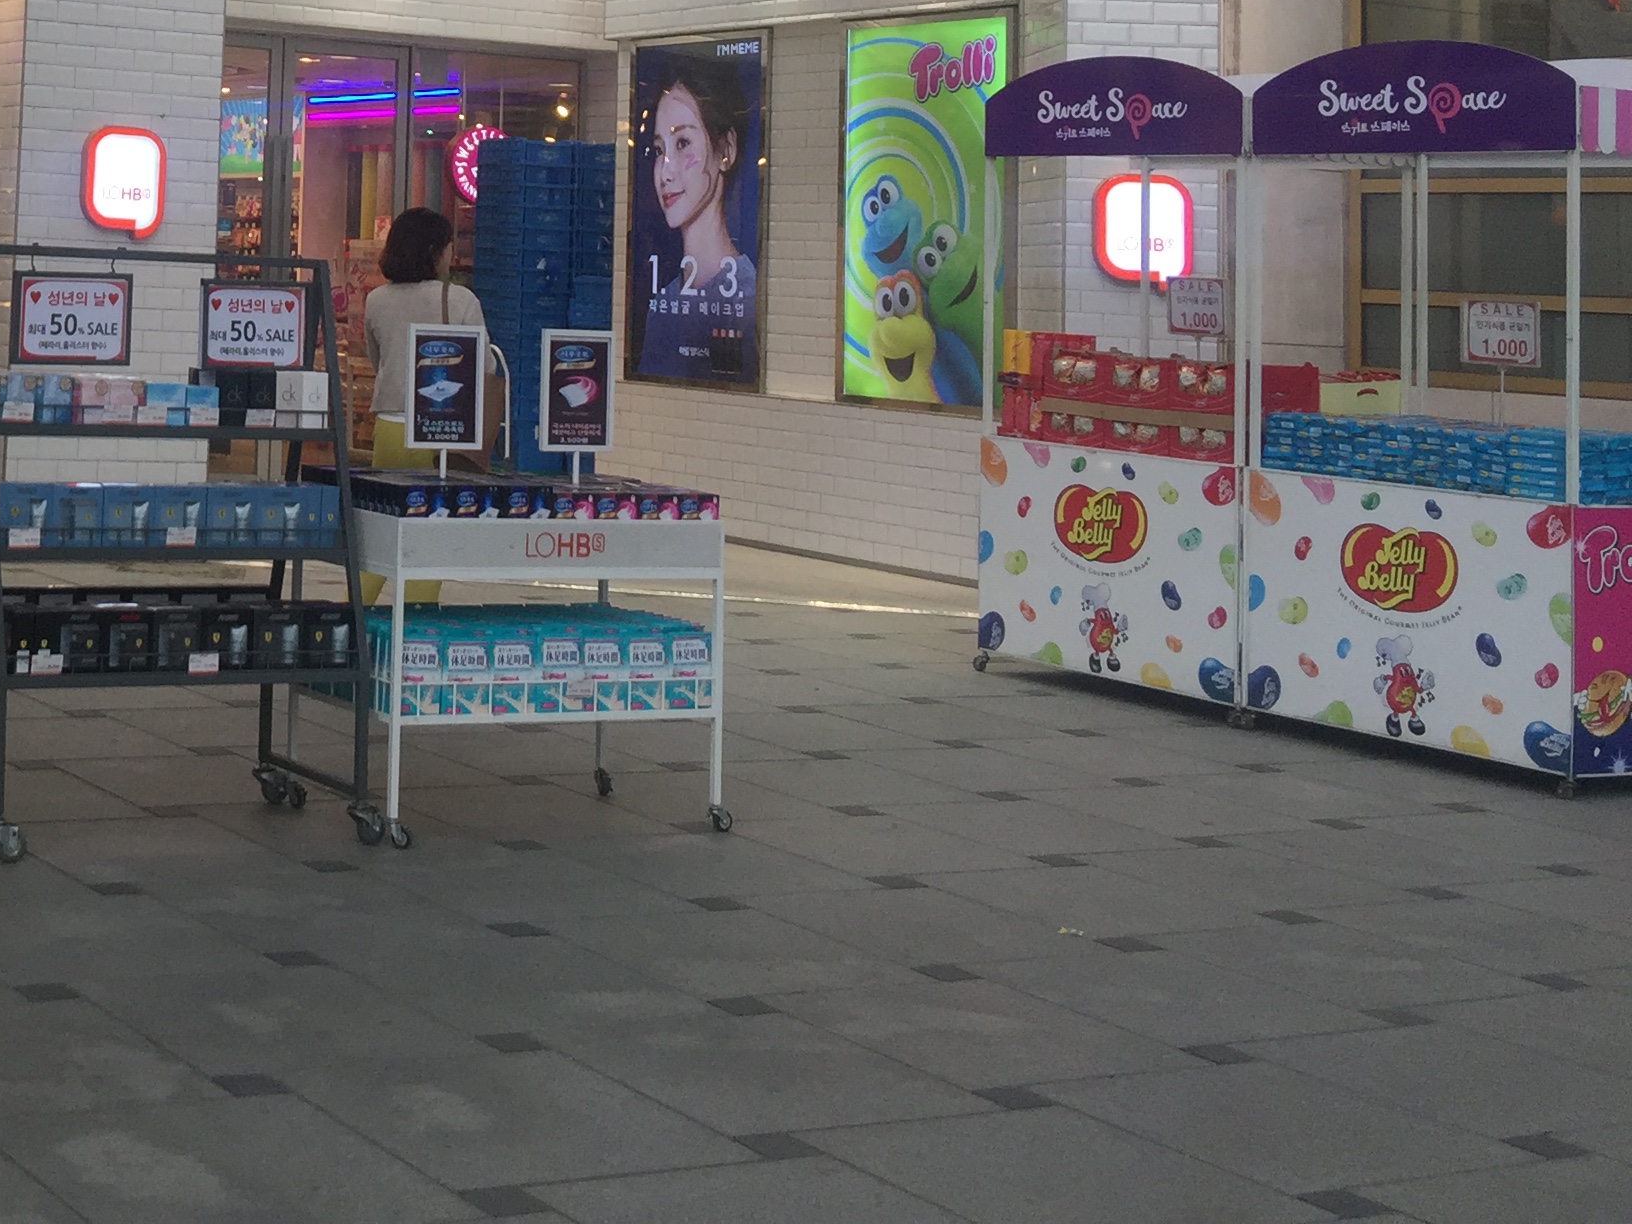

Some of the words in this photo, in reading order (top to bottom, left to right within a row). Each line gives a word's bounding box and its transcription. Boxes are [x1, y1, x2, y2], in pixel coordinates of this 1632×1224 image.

[731, 41, 760, 55] MEME
[908, 33, 997, 104] Trolli
[1037, 90, 1102, 123] Sweet
[1317, 79, 1399, 117] Sweet
[648, 254, 667, 295] 1.
[679, 256, 706, 297] 2.
[718, 256, 744, 298] 3.
[47, 290, 88, 307] 성년의
[93, 291, 107, 307] 날
[227, 298, 267, 314] 성년의
[270, 299, 283, 314] 날
[698, 301, 744, 318] 메이크업
[1480, 303, 1524, 317] SALE
[28, 323, 46, 335] 최대
[87, 321, 119, 336] SALE
[1180, 311, 1218, 329] 1,000
[209, 330, 227, 342] 최대
[265, 329, 295, 343] SALE
[1482, 338, 1528, 358] 1,000
[1081, 486, 1122, 529] Jelly
[524, 532, 606, 559] LOHBS
[1066, 517, 1114, 561] Belly
[1375, 526, 1426, 574] Jelly
[1357, 560, 1416, 611] Belly
